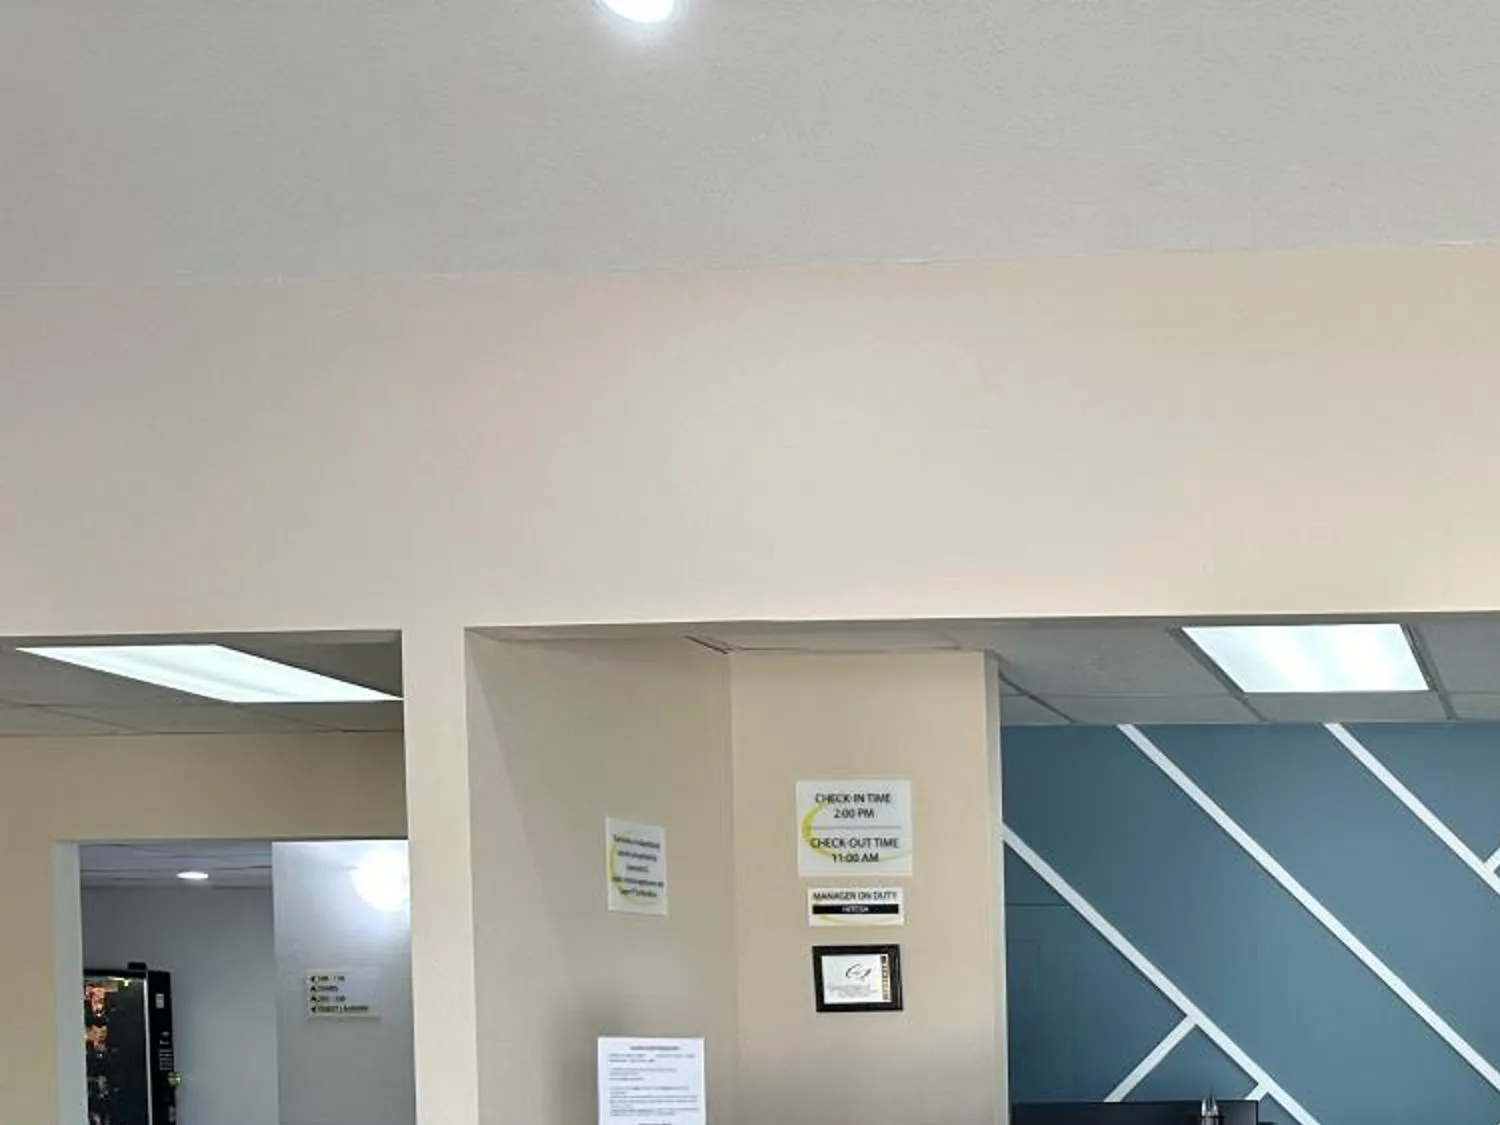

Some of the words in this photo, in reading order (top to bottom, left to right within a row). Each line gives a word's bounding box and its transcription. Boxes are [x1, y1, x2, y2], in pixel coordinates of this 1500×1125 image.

[867, 793, 890, 803] TIME
[857, 808, 874, 818] PM
[873, 838, 899, 848] TIME
[861, 853, 879, 862] AM
[813, 891, 856, 900] MANAGER
[858, 891, 873, 900] ON
[874, 891, 897, 900] DUTY
